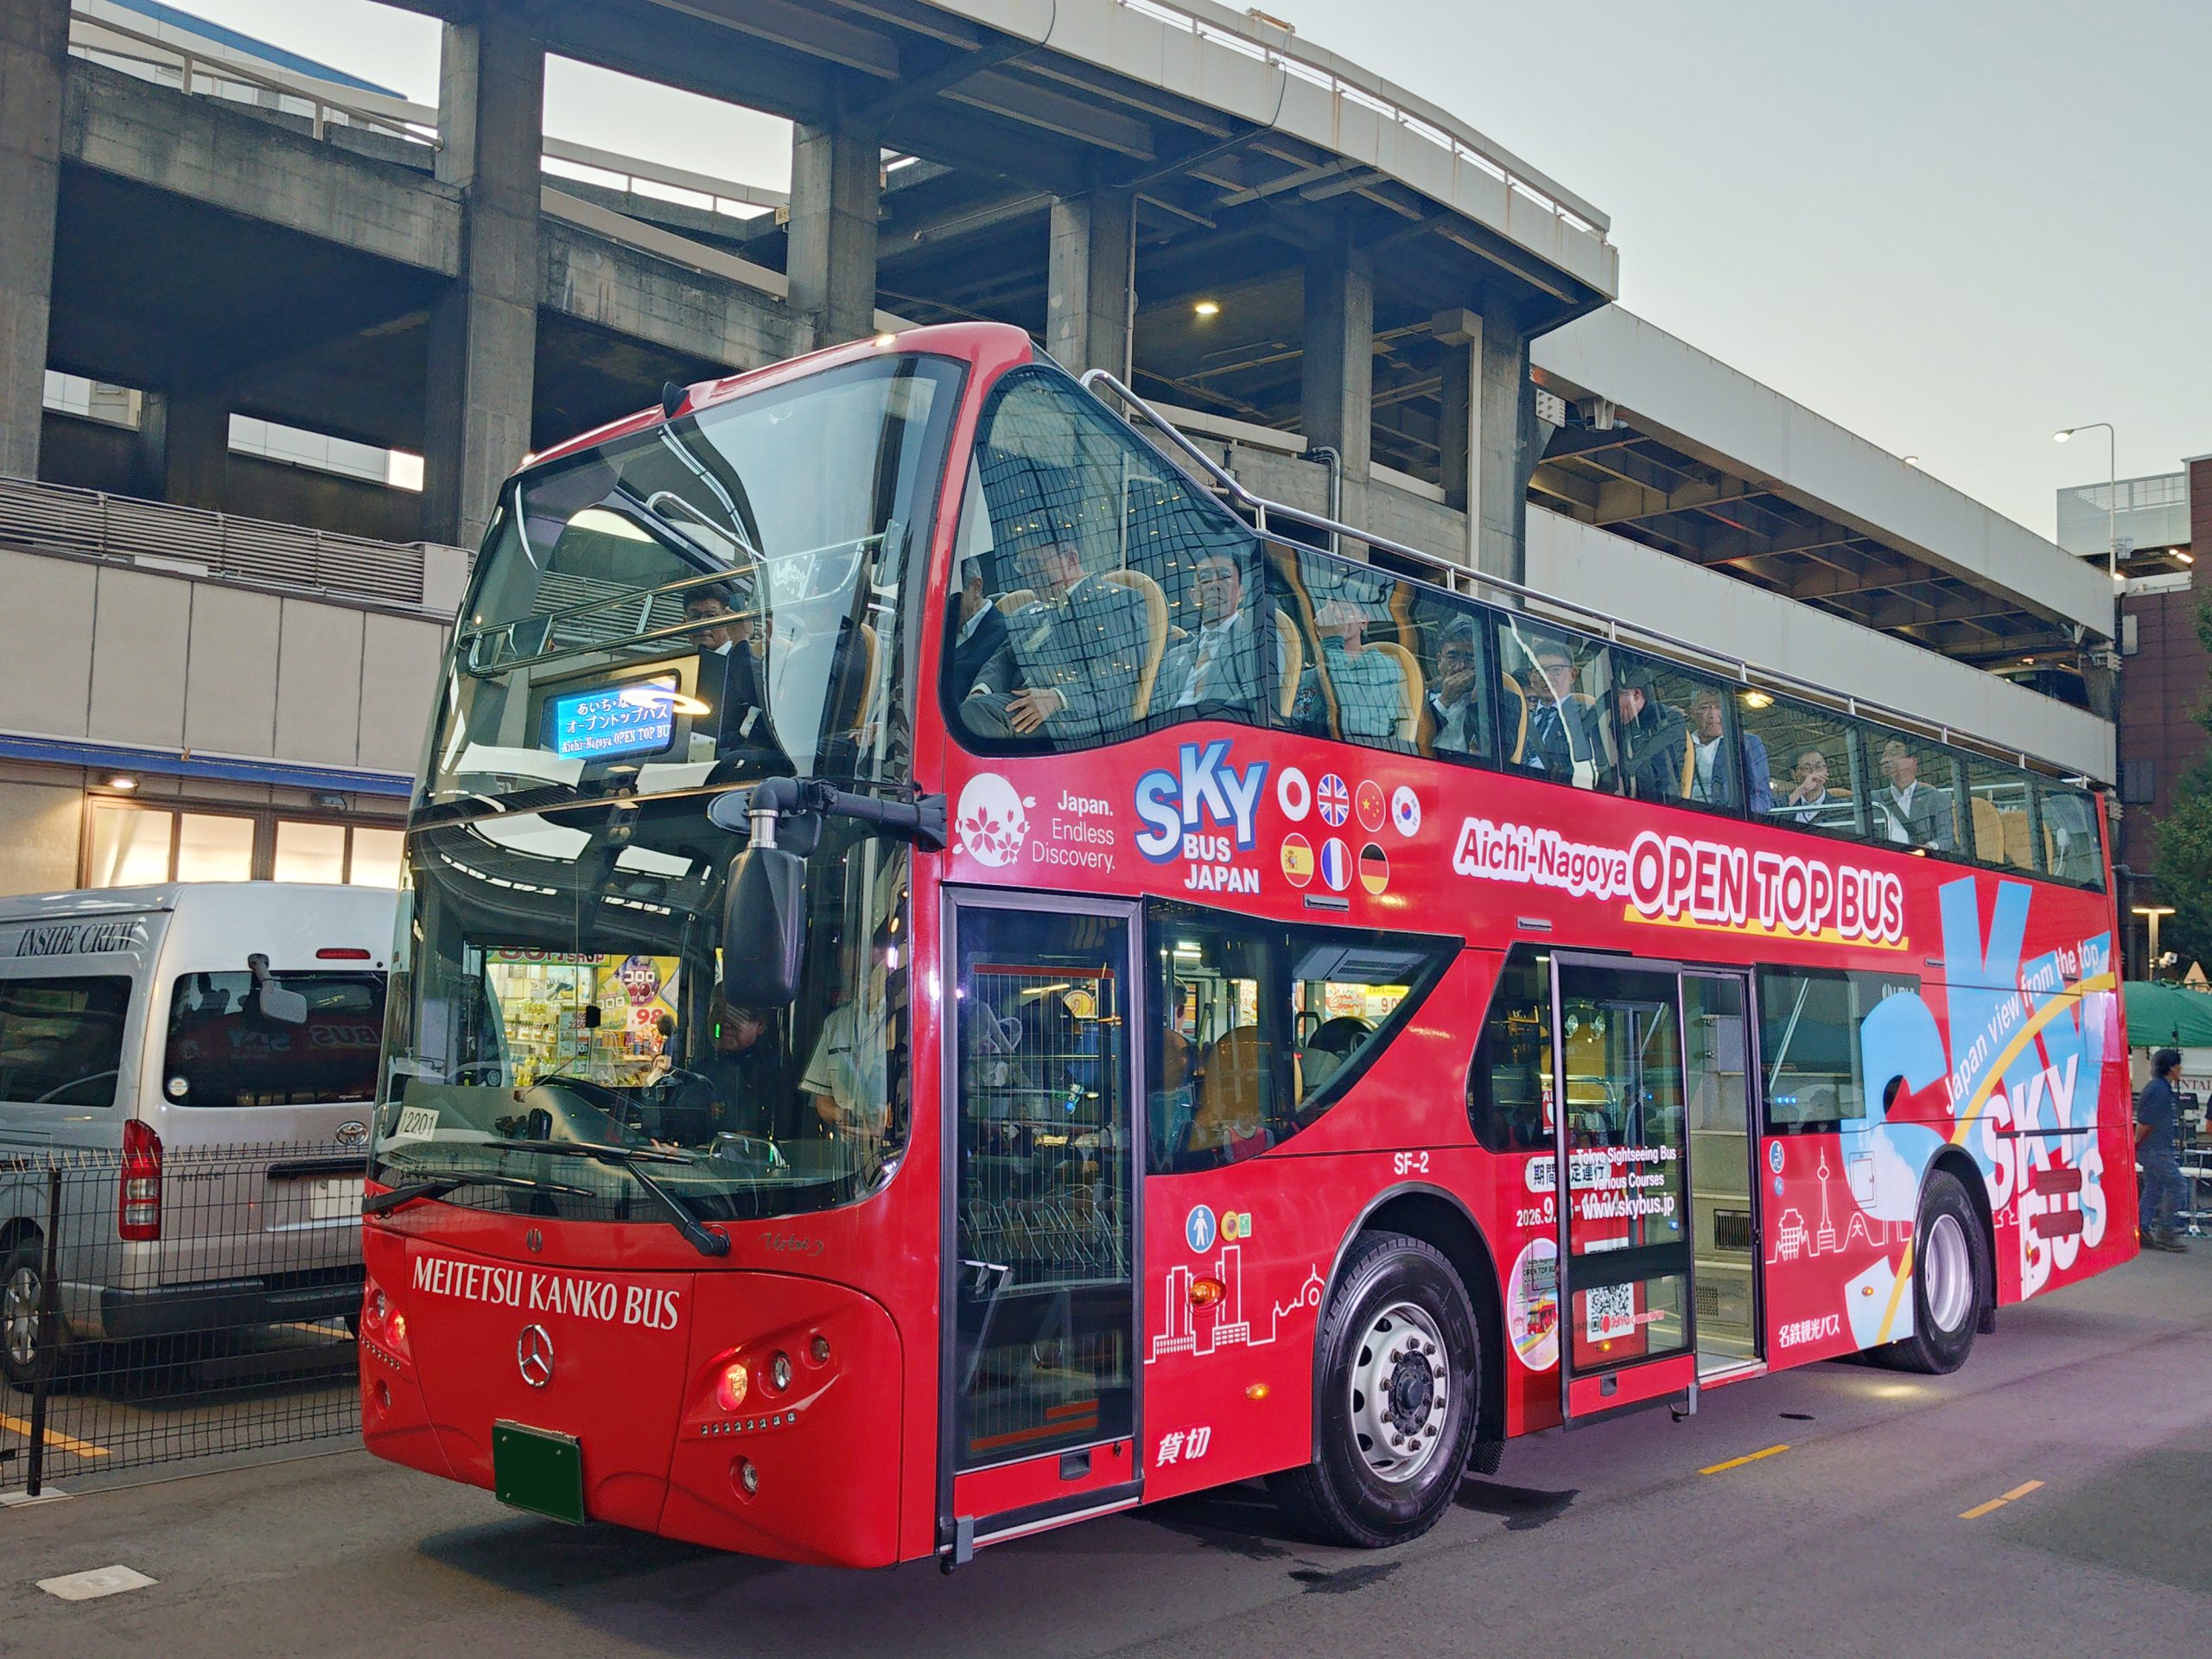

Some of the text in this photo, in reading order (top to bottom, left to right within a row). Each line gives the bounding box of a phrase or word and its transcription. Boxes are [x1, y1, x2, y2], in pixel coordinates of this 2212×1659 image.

[577, 696, 632, 715] あいち・な
[562, 723, 671, 753] Aichi-Nagoya OPEN TOP BU
[1057, 789, 1114, 817] Japan.
[1135, 739, 1270, 865] SKY
[1052, 818, 1115, 846] Endless
[1032, 840, 1116, 872] Discovery.
[1182, 836, 1233, 863] BUS
[1183, 863, 1261, 894] JAPAN
[1456, 821, 1904, 943] Aichi-Nagoya OPEN TOP BUS
[16, 921, 143, 957] INSIDE CREW
[1945, 939, 2100, 1115] Japan view from the top
[400, 1110, 435, 1136] 12201
[1982, 1053, 2079, 1210] SKY
[1394, 1151, 1430, 1175] SF-2
[1576, 1145, 1677, 1166] Tokyo Sightseeing Bus
[1534, 1162, 1605, 1186] 期間定運行
[1593, 1173, 1665, 1192] Various Courses
[1581, 1192, 1675, 1220] www.skybus.jp
[2018, 1147, 2107, 1301] BUS
[412, 1256, 680, 1331] MEITETSU KANKO BUS
[1779, 1313, 1840, 1348] 名鉄観光バス
[1155, 1426, 1211, 1468] 貸切
